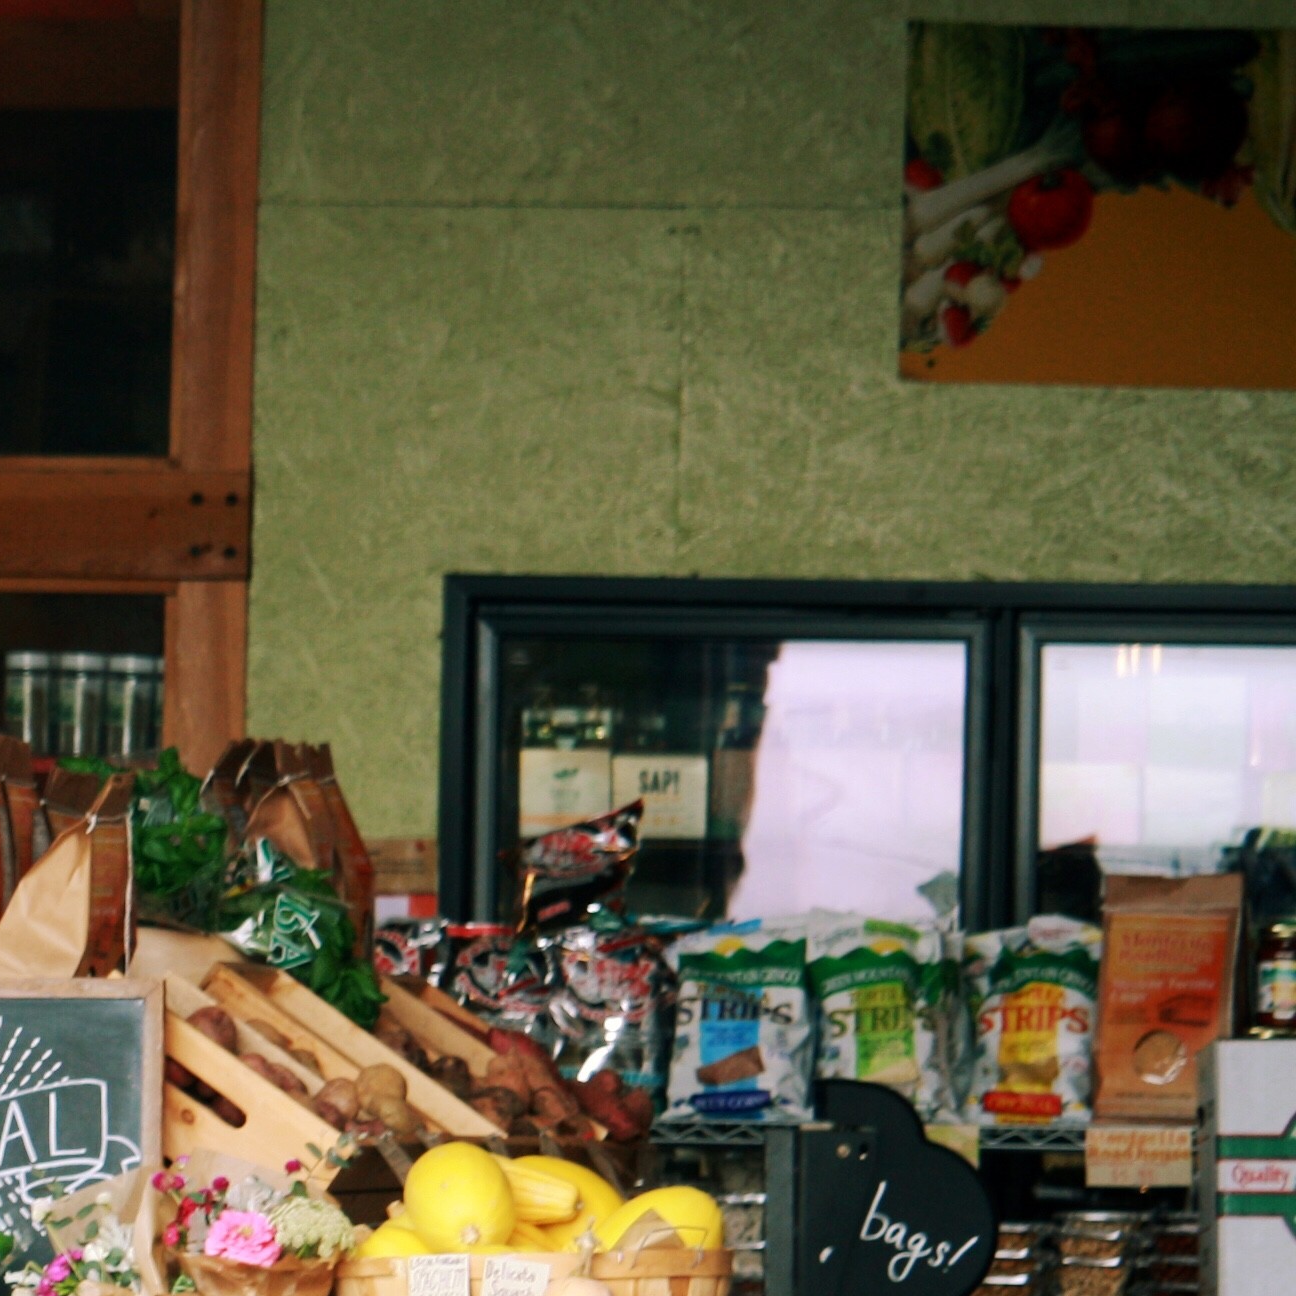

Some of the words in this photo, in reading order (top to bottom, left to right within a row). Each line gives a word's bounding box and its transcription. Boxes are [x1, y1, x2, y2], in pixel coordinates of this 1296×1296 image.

[638, 770, 682, 795] SAP!
[675, 996, 793, 1026] STRIPS
[978, 1003, 1091, 1036] STRIPS
[1232, 1161, 1290, 1191] Quality
[859, 1178, 980, 1284] bags!
